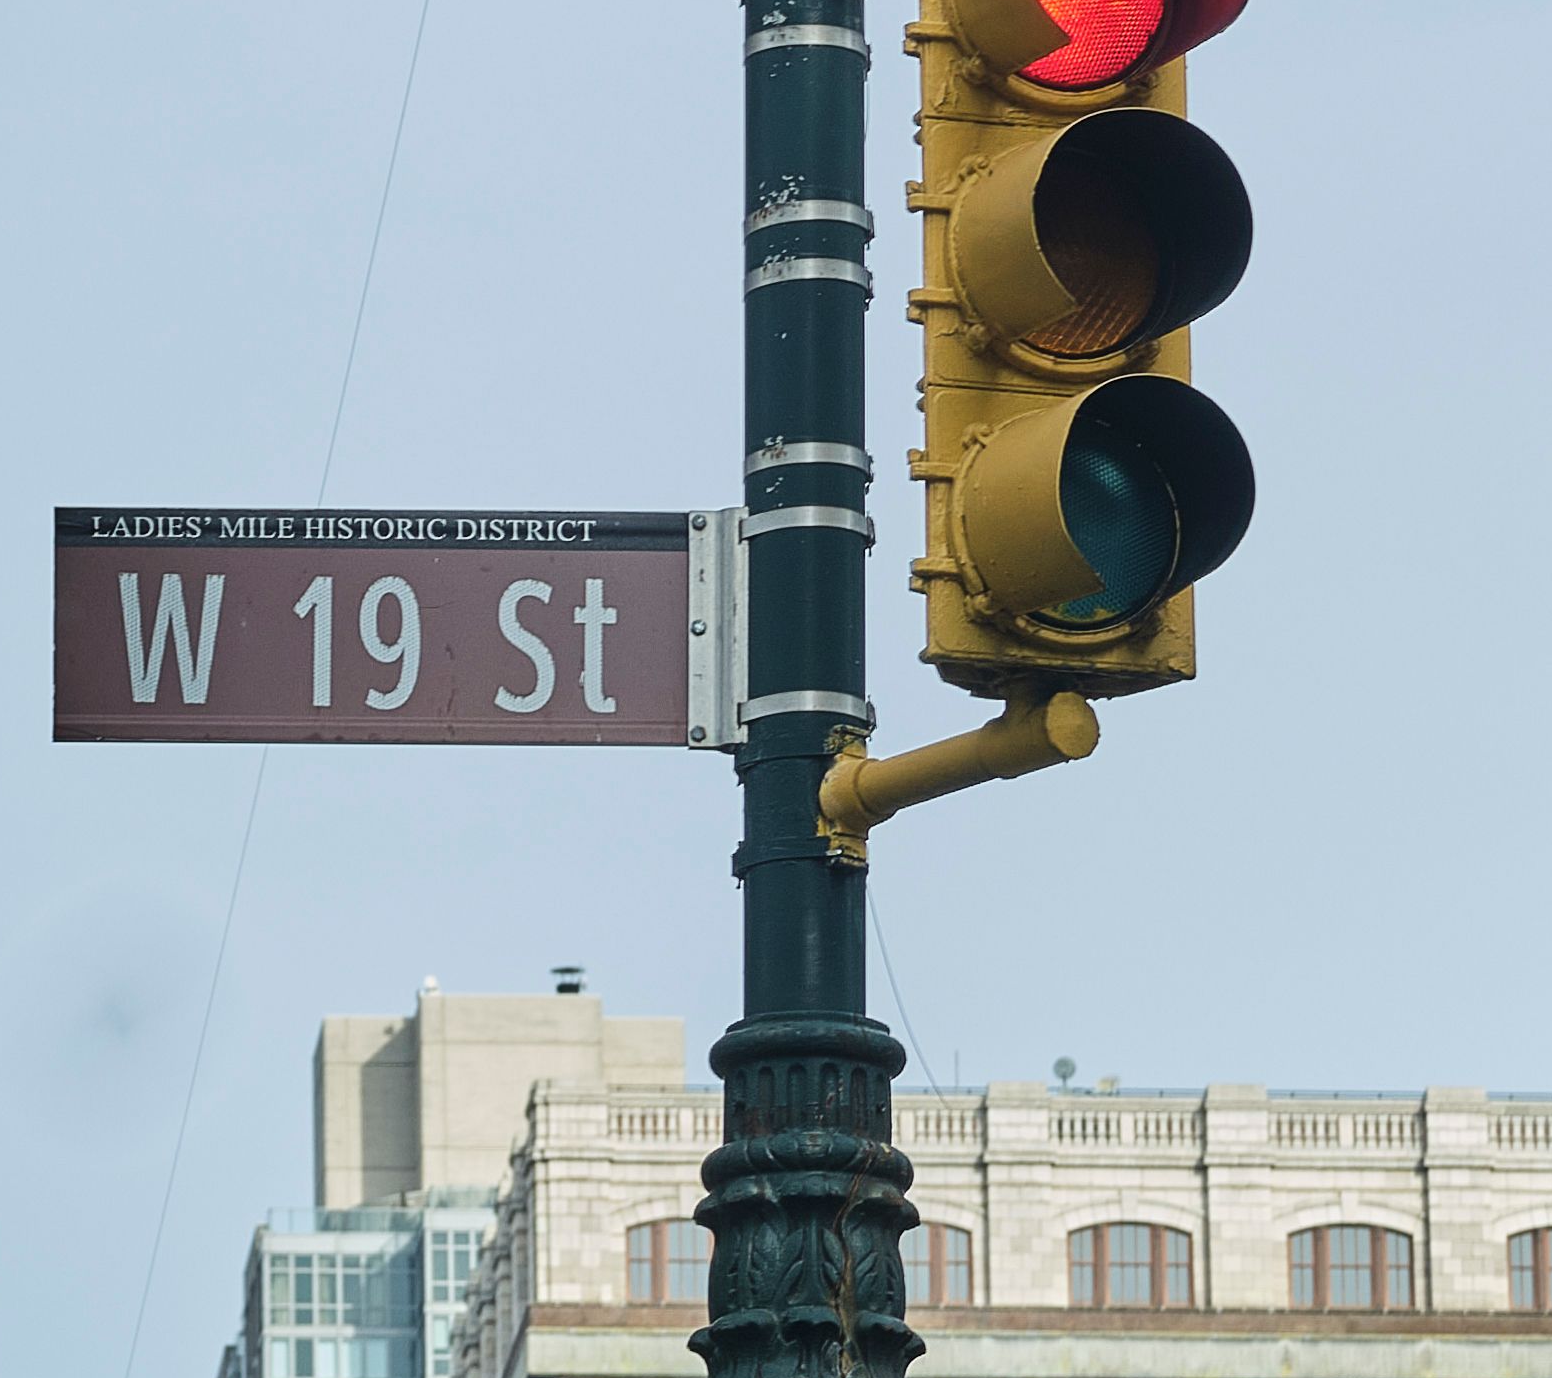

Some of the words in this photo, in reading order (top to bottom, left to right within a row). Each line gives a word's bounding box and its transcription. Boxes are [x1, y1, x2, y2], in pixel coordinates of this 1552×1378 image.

[92, 516, 212, 539] LADIES’
[219, 516, 295, 539] MILE
[304, 517, 447, 540] HISTORIC
[455, 518, 597, 542] DISTRICT
[118, 572, 226, 704] W
[293, 576, 422, 710] 19
[494, 578, 618, 713] St
